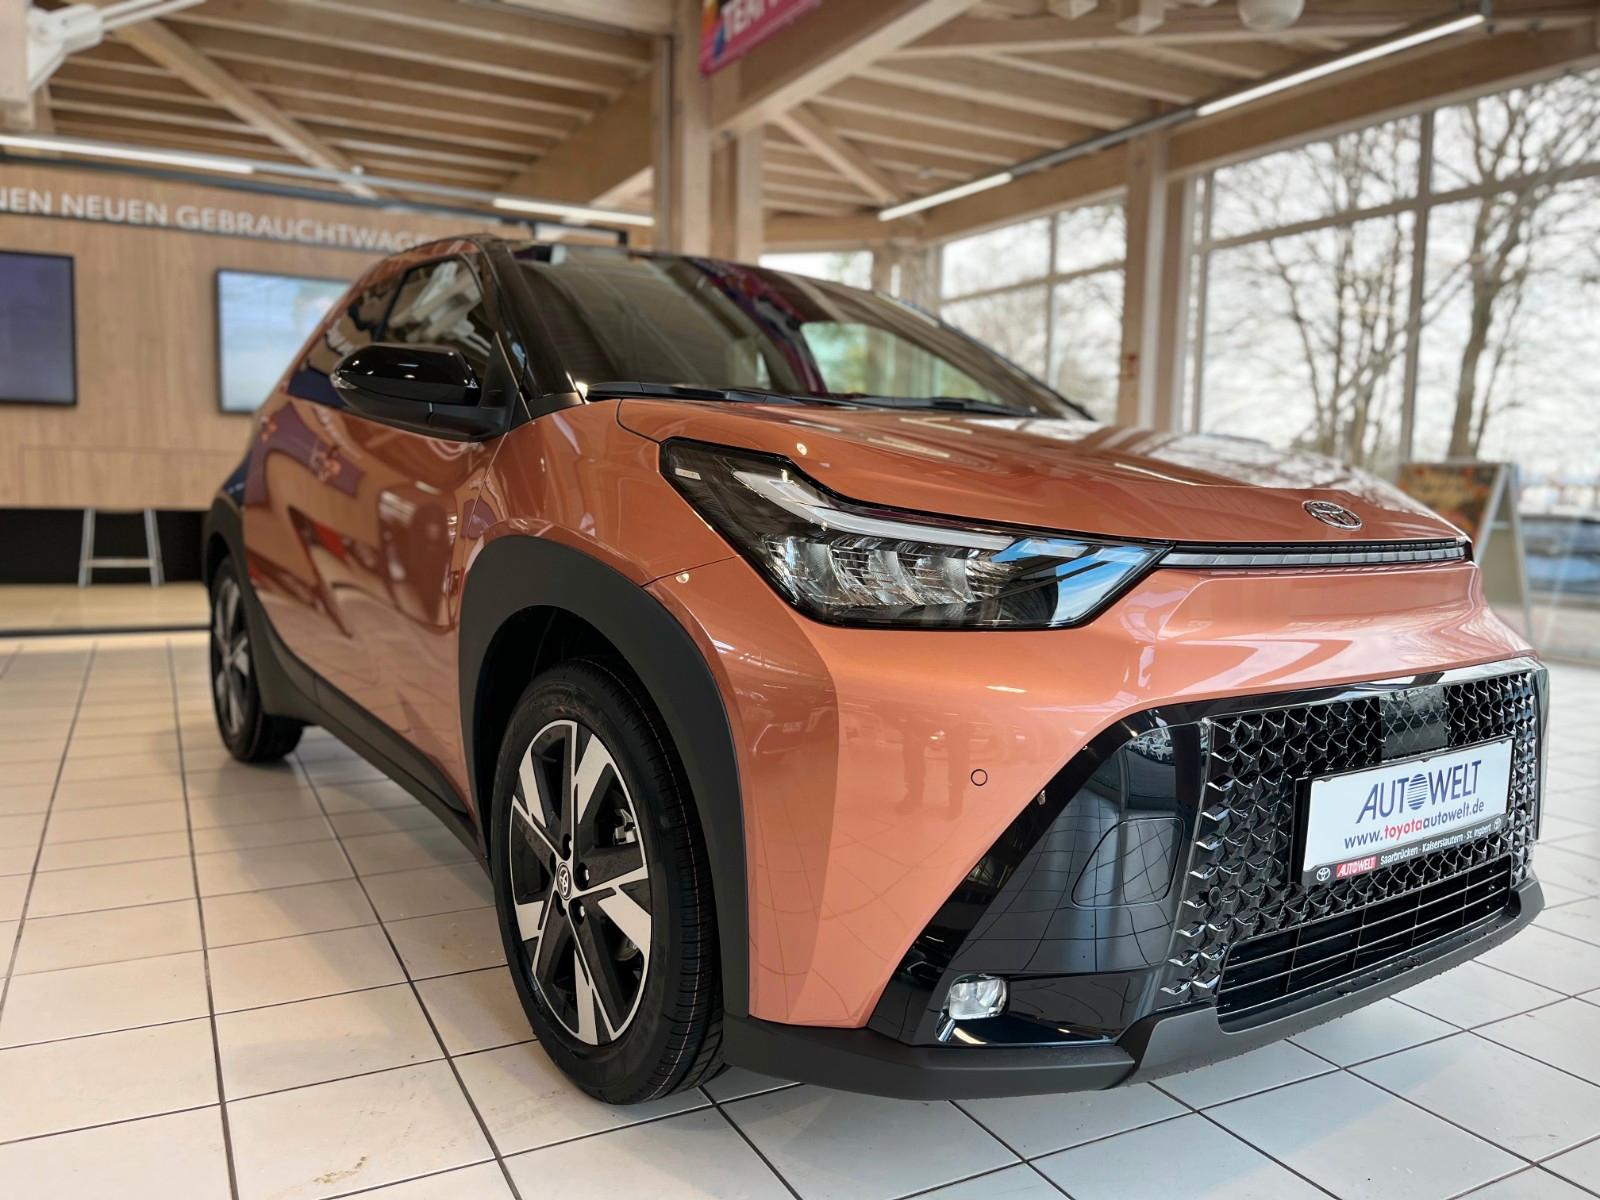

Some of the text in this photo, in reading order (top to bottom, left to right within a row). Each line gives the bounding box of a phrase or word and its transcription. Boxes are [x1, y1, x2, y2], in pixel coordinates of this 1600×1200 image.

[60, 192, 168, 225] NEUEN
[1355, 760, 1482, 824] AUTOWELT
[1344, 798, 1485, 849] www.toyotaautowelt.de
[1337, 857, 1376, 878] AUTOWELT
[1380, 846, 1418, 866] Saarbrücken
